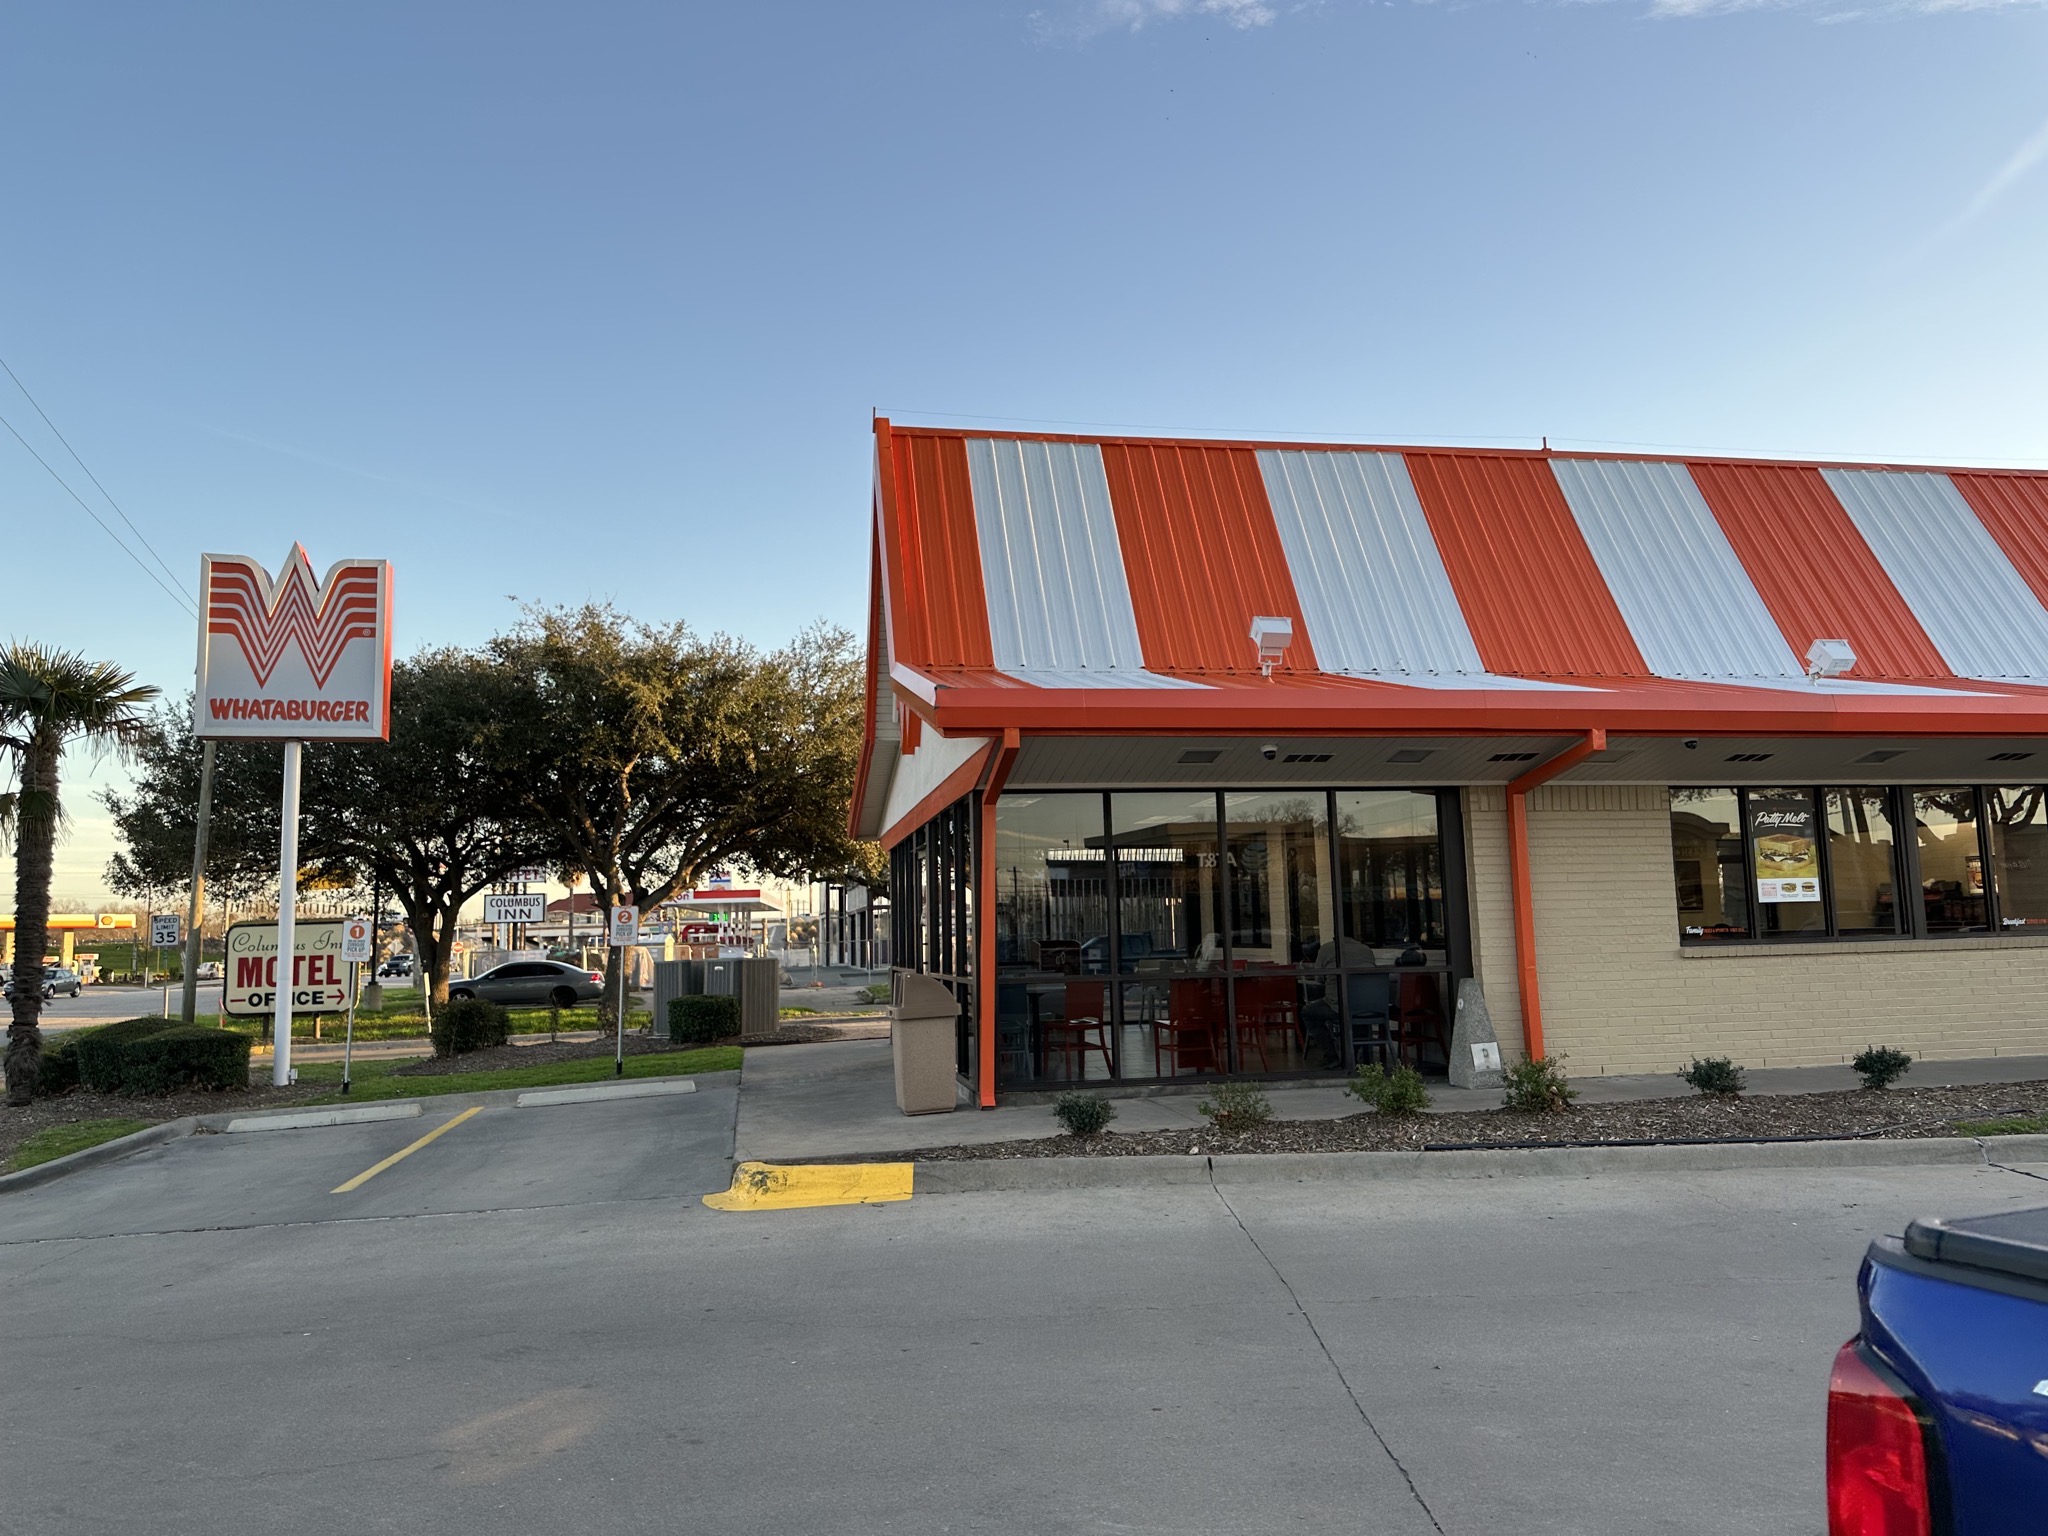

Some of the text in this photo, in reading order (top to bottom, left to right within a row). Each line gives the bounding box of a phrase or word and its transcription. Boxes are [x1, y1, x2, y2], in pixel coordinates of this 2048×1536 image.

[210, 698, 370, 722] WHATABURGER
[1755, 811, 1810, 828] Patty Melt
[490, 897, 540, 908] COLUMBUS
[498, 908, 531, 920] INN
[155, 931, 176, 943] 35
[1685, 925, 1704, 936] Family
[232, 932, 306, 953] Columus
[248, 991, 324, 1007] OFICE
